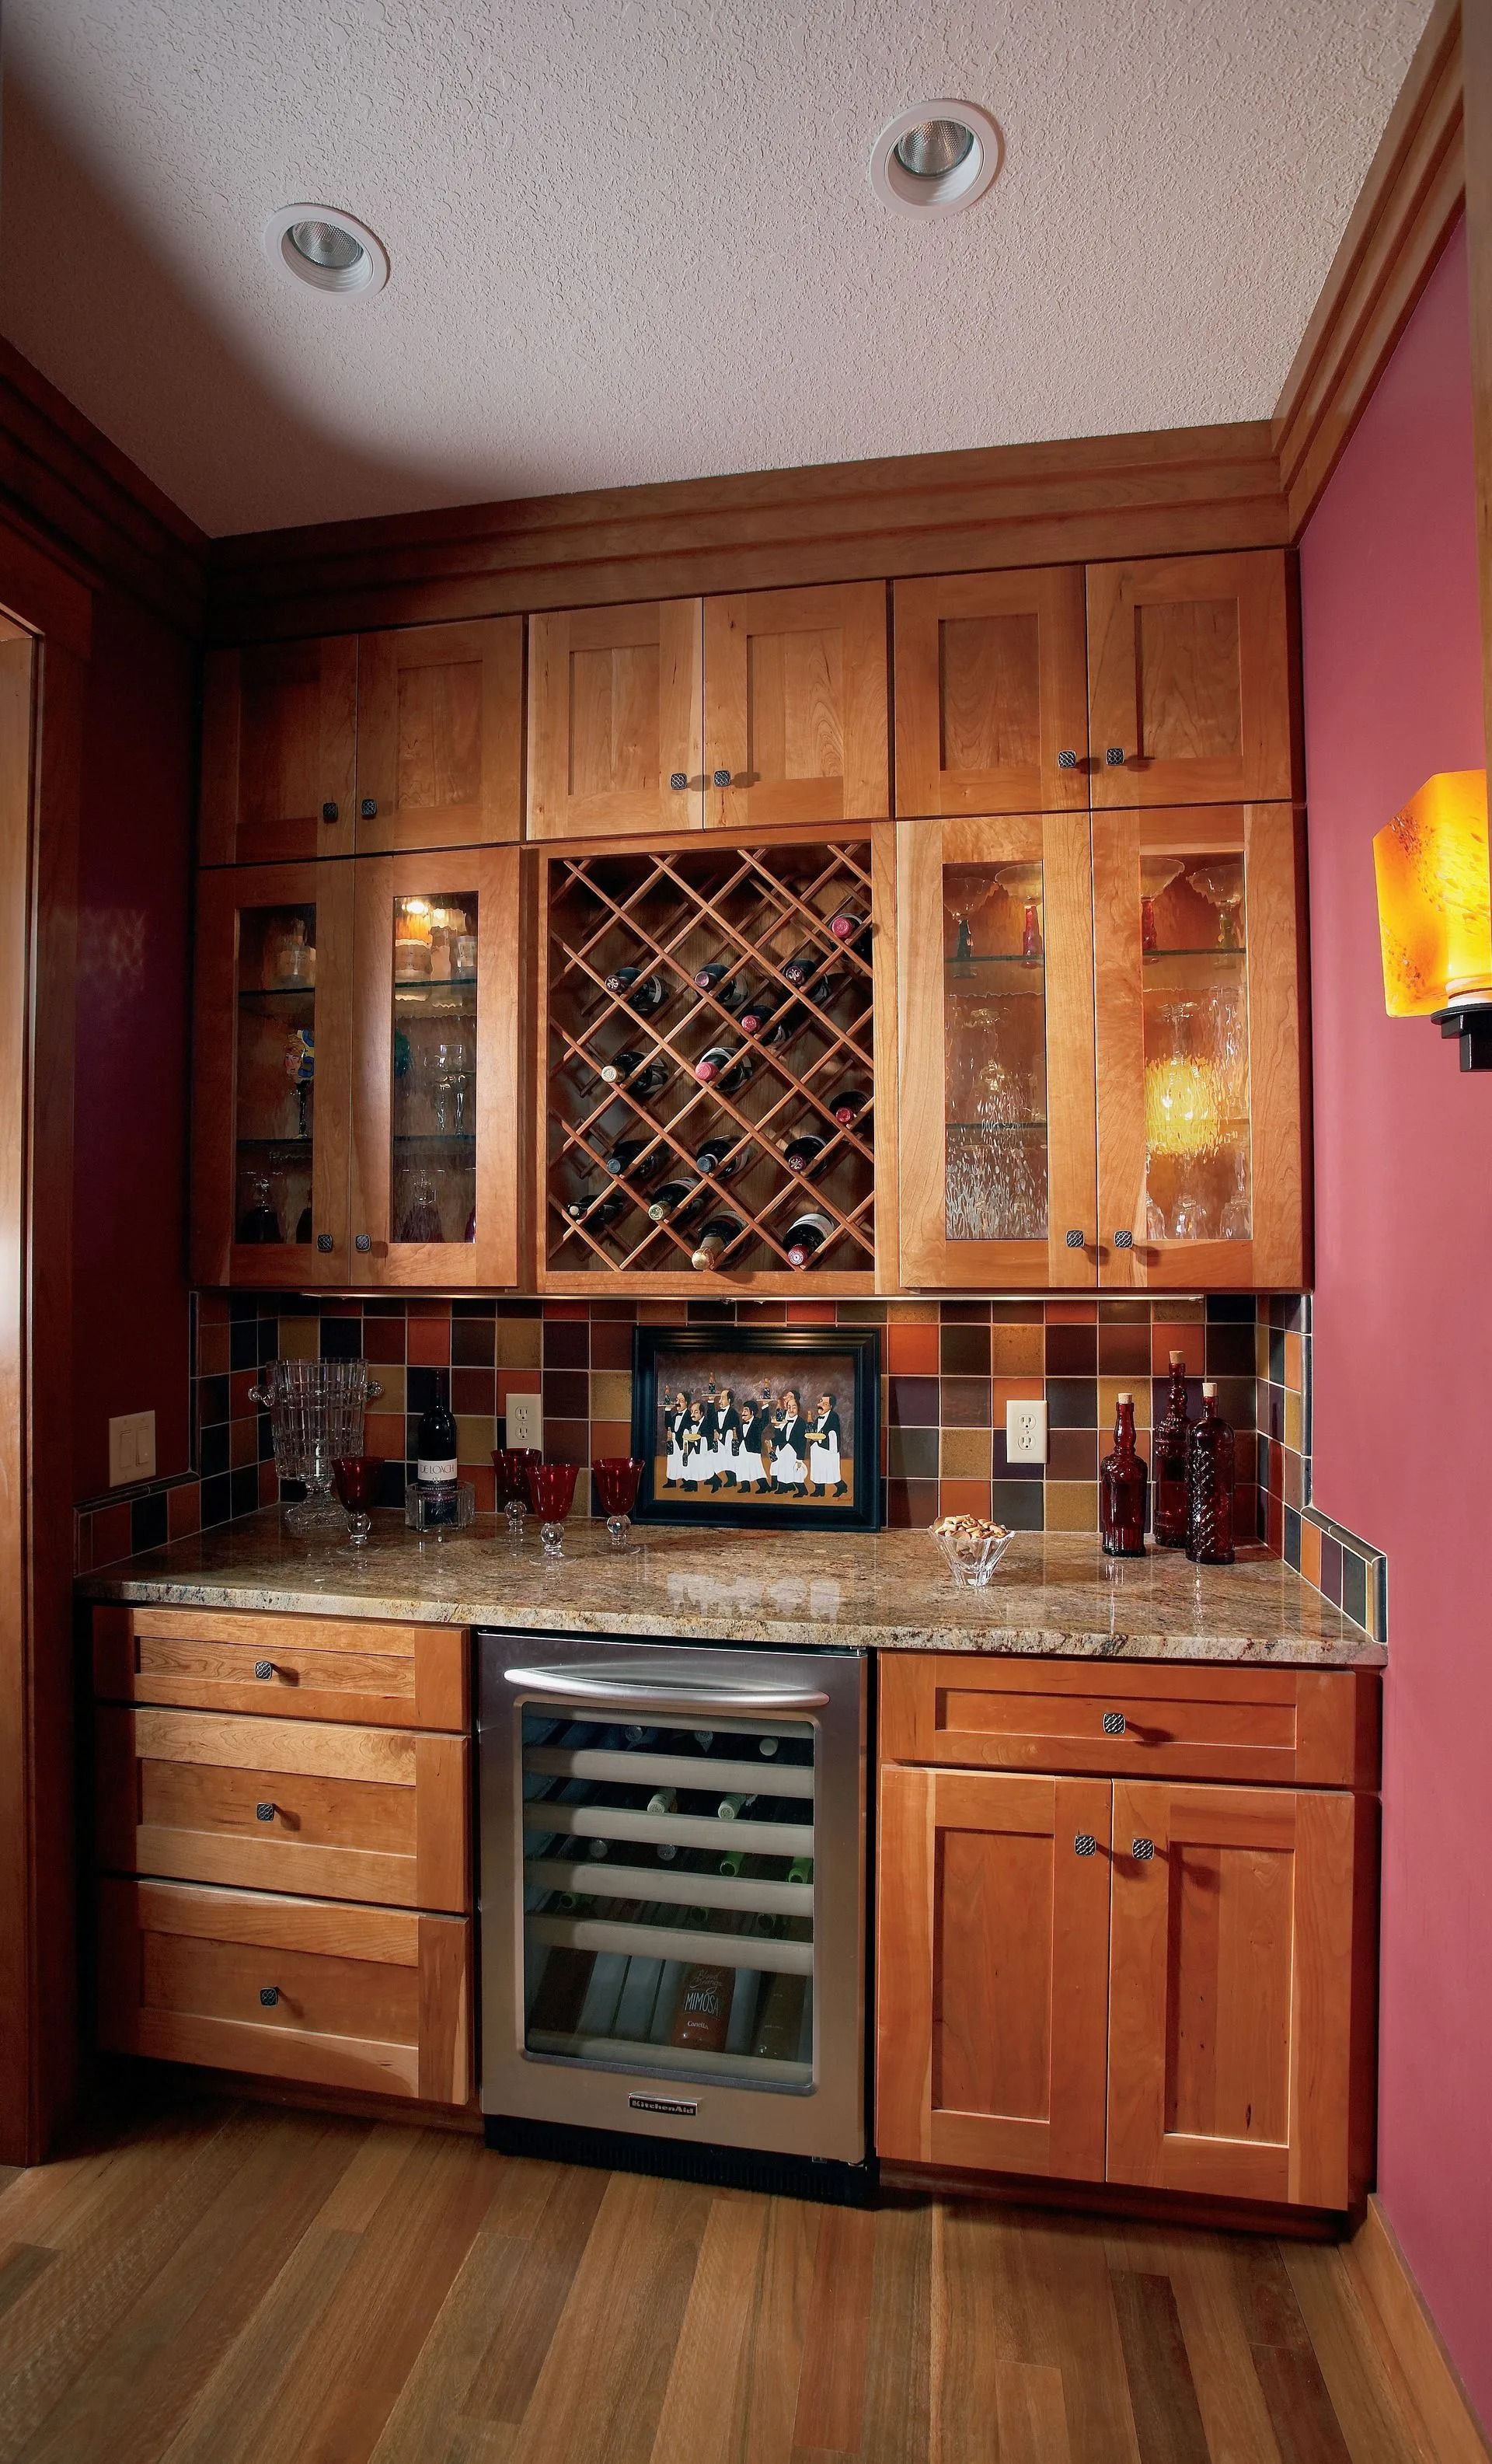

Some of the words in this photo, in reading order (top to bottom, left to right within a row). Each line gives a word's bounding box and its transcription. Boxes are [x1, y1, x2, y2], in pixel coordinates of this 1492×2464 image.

[420, 1464, 428, 1474] DE
[430, 1464, 455, 1474] LOACH
[684, 1992, 719, 2016] MIMOSA
[632, 2099, 694, 2114] KitchenAid
